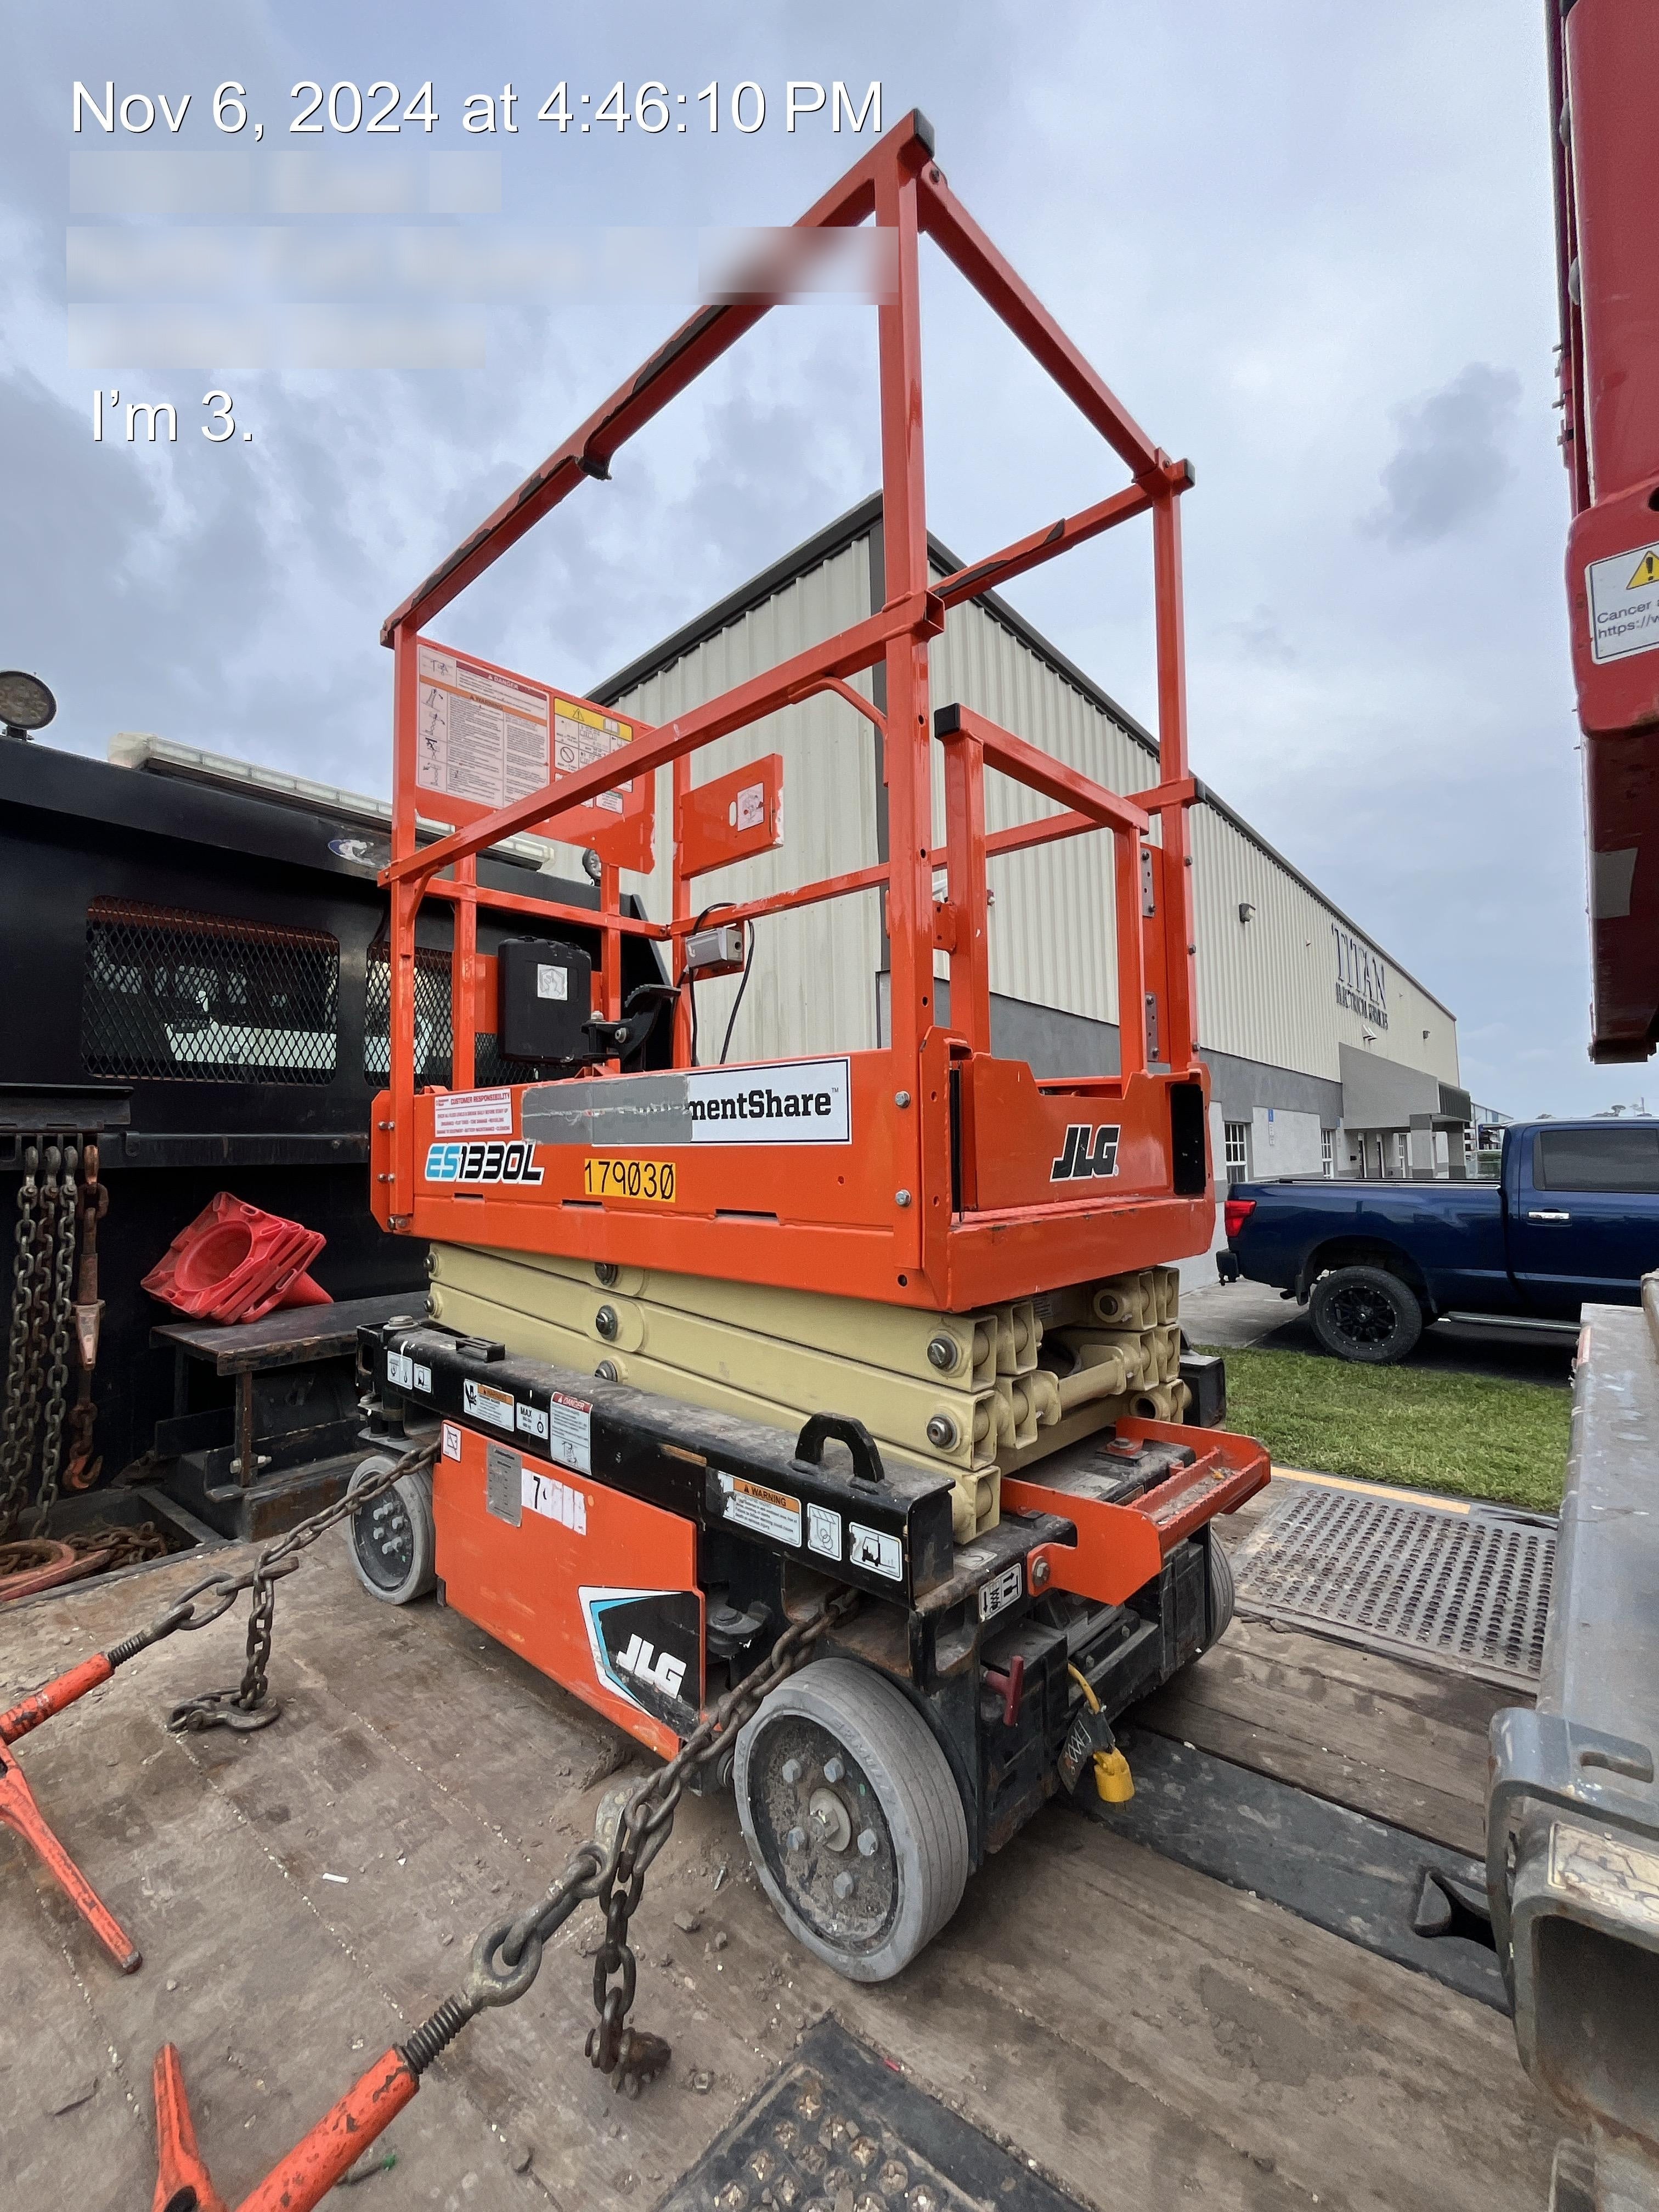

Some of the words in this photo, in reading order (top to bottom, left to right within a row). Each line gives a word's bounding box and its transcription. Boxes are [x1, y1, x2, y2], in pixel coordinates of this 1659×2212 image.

[1597, 601, 1652, 624] Cancer
[494, 675, 518, 690] DANGER
[1331, 922, 1386, 1010] TITAN
[450, 1097, 472, 1105] CUSTOMER
[473, 1092, 510, 1103] RESPONSIBILITY
[425, 1141, 544, 1184] ES1330L
[1050, 1124, 1121, 1182] JLG
[585, 1160, 674, 1199] 179030
[520, 1406, 532, 1417] MAX
[563, 1396, 585, 1410] DANGER
[751, 1486, 786, 1507] WARNING
[616, 1633, 687, 1700] JLG
